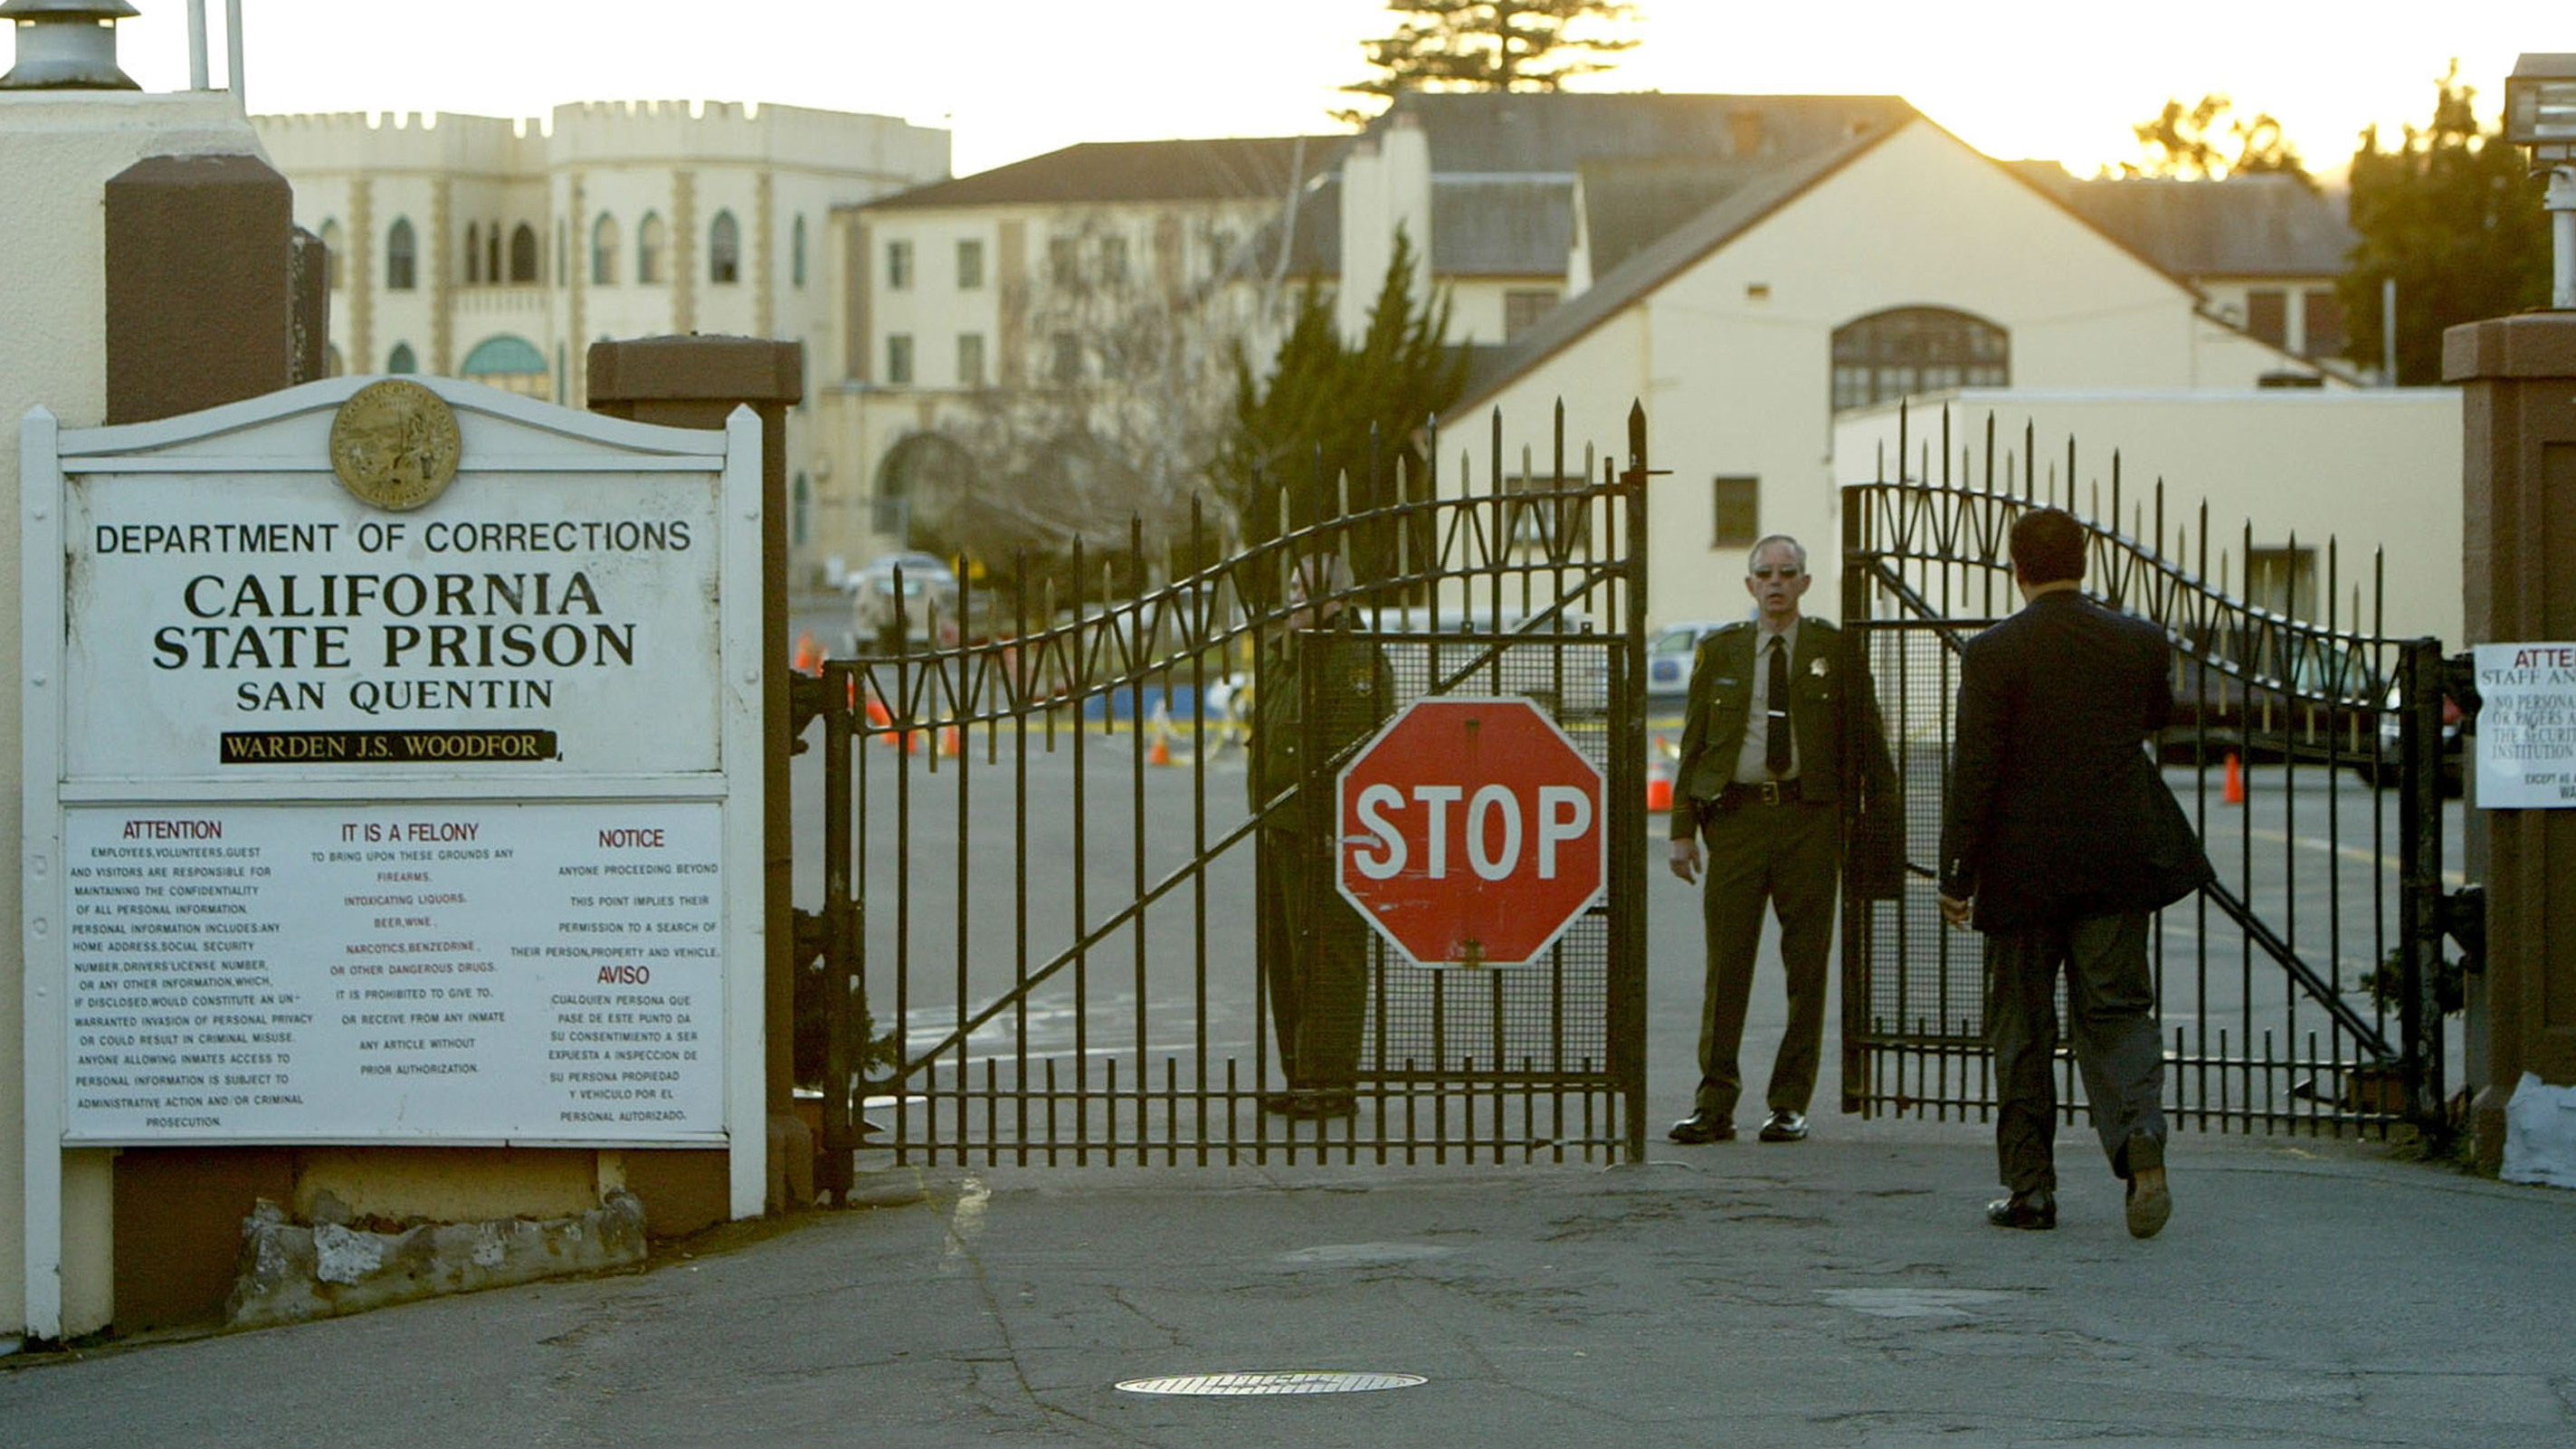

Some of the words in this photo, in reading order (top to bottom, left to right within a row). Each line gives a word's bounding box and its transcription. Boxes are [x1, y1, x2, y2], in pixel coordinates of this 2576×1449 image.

[96, 524, 339, 554] DEPARTMENT
[360, 522, 405, 553] OF
[425, 520, 691, 553] CORRECTIONS
[184, 571, 602, 618] CALIFORNIA
[153, 624, 351, 671] STATE
[383, 623, 637, 668] PRISON
[2514, 648, 2576, 668] ATTE
[2482, 669, 2541, 685] STAFF
[236, 682, 325, 712] SAN
[349, 680, 554, 715] QUENTIN
[226, 736, 346, 758] WARDEN
[356, 736, 394, 758] J.S.
[404, 734, 539, 758] WOODFOR
[2492, 744, 2573, 759] INSTITUTION
[123, 820, 223, 841] ATTENTION
[342, 825, 357, 843] IT
[364, 825, 381, 843] IS
[388, 824, 402, 843] A
[408, 823, 480, 842] FELONY
[1354, 783, 1592, 881] STOP
[599, 829, 664, 847] NOTICE
[311, 851, 326, 862] TO
[329, 851, 363, 862] BRING
[366, 851, 396, 862] UPON
[400, 850, 433, 861] THESE
[438, 849, 490, 860] GROUNDS
[495, 849, 514, 858] ANY
[70, 867, 92, 877] AND
[95, 866, 144, 877] VISITORS
[147, 867, 168, 877] ARE
[173, 866, 245, 877] RESPONSIBLE
[251, 866, 271, 876] FOR
[558, 865, 600, 875] ANYONE
[604, 863, 672, 875] PROCEEDING
[676, 863, 719, 873] BEYOND
[74, 885, 141, 896] MAINTAINING
[145, 885, 165, 896] THE
[169, 885, 259, 896] CONFIDENTIALITY
[344, 894, 414, 906] INTOXICATING
[570, 896, 595, 907] THIS
[599, 896, 630, 906] POINT
[633, 896, 675, 906] IMPLIES
[680, 895, 709, 905] THEIR
[76, 904, 91, 915] OF
[94, 905, 113, 915] ALL
[117, 904, 172, 914] PERSONAL
[71, 923, 127, 934] PERSONAL
[131, 923, 202, 933] INFORMATION
[558, 922, 624, 932] PERMISSION
[628, 922, 642, 932] TO
[645, 922, 653, 931] A
[656, 922, 699, 932] SEARCH
[703, 921, 718, 931] OF
[72, 941, 103, 951] HOME
[203, 940, 255, 951] SECURITY
[510, 946, 541, 957] THEIR
[648, 948, 670, 958] AND
[329, 965, 346, 976] OR
[349, 964, 385, 976] OTHER
[388, 963, 454, 974] DANGEROUS
[597, 966, 650, 985] AVISO
[79, 979, 95, 990] OR
[99, 980, 119, 989] ANY
[123, 978, 158, 989] OTHER
[336, 989, 346, 999] IT
[349, 989, 361, 1000] IS
[365, 988, 427, 999] PROHIBITED
[430, 987, 445, 998] TO
[448, 987, 472, 998] GIVE
[551, 994, 613, 1005] CUALQUIEN
[616, 995, 666, 1006] PERSONA
[669, 996, 691, 1006] QUE
[74, 996, 84, 1007] IF
[192, 995, 255, 1006] CONSTITUTE
[261, 995, 275, 1004] AN
[74, 1015, 138, 1027] WARRANTED
[141, 1015, 191, 1026] INVASION
[195, 1015, 208, 1025] OF
[213, 1015, 268, 1025] PERSONAL
[271, 1014, 313, 1024] PRIVACY
[341, 1014, 357, 1025] OR
[361, 1014, 405, 1025] RECEIVE
[410, 1013, 441, 1023] FROM
[444, 1013, 464, 1022] ANY
[468, 1012, 506, 1022] INMATE
[558, 1013, 585, 1024] PASE
[588, 1013, 604, 1024] DE
[608, 1013, 634, 1024] ESTE
[639, 1013, 673, 1023] PUNTO
[677, 1014, 692, 1024] DA
[79, 1034, 95, 1046] OR
[99, 1034, 136, 1046] COULD
[139, 1034, 179, 1045] RESULT
[183, 1034, 195, 1044] IN
[198, 1033, 249, 1044] CRIMINAL
[550, 1030, 566, 1042] SU
[569, 1031, 662, 1042] CONSENTIMIENTO
[666, 1032, 673, 1041] A
[677, 1031, 699, 1042] SER
[359, 1040, 380, 1050] ANY
[384, 1039, 425, 1050] ARTICLE
[430, 1037, 476, 1048] WITHOUT
[78, 1054, 119, 1065] ANYONE
[123, 1054, 177, 1065] ALLOWING
[181, 1053, 226, 1064] INMATES
[230, 1053, 273, 1063] ACCESS
[277, 1053, 290, 1063] TO
[548, 1049, 601, 1060] EXPUESTA
[604, 1051, 612, 1060] A
[614, 1050, 680, 1060] INSPECCION
[683, 1050, 698, 1061] DE
[360, 1064, 393, 1074] PRIOR
[75, 1075, 130, 1086] PERSONAL
[134, 1074, 205, 1085] INFORMATION
[209, 1074, 221, 1085] IS
[224, 1073, 271, 1085] SUBJECT
[276, 1073, 290, 1083] TO
[549, 1072, 565, 1082] SU
[568, 1072, 619, 1082] PERSONA
[622, 1071, 680, 1082] PROPIEDAD
[569, 1090, 576, 1098] Y
[580, 1089, 633, 1100] VEHICULO
[635, 1089, 657, 1099] POR
[661, 1089, 674, 1100] EL
[77, 1097, 160, 1109] ADMINISTRATIVE
[166, 1096, 204, 1107] ACTION
[254, 1094, 304, 1104] CRIMINAL
[560, 1111, 615, 1121] PERSONAL
